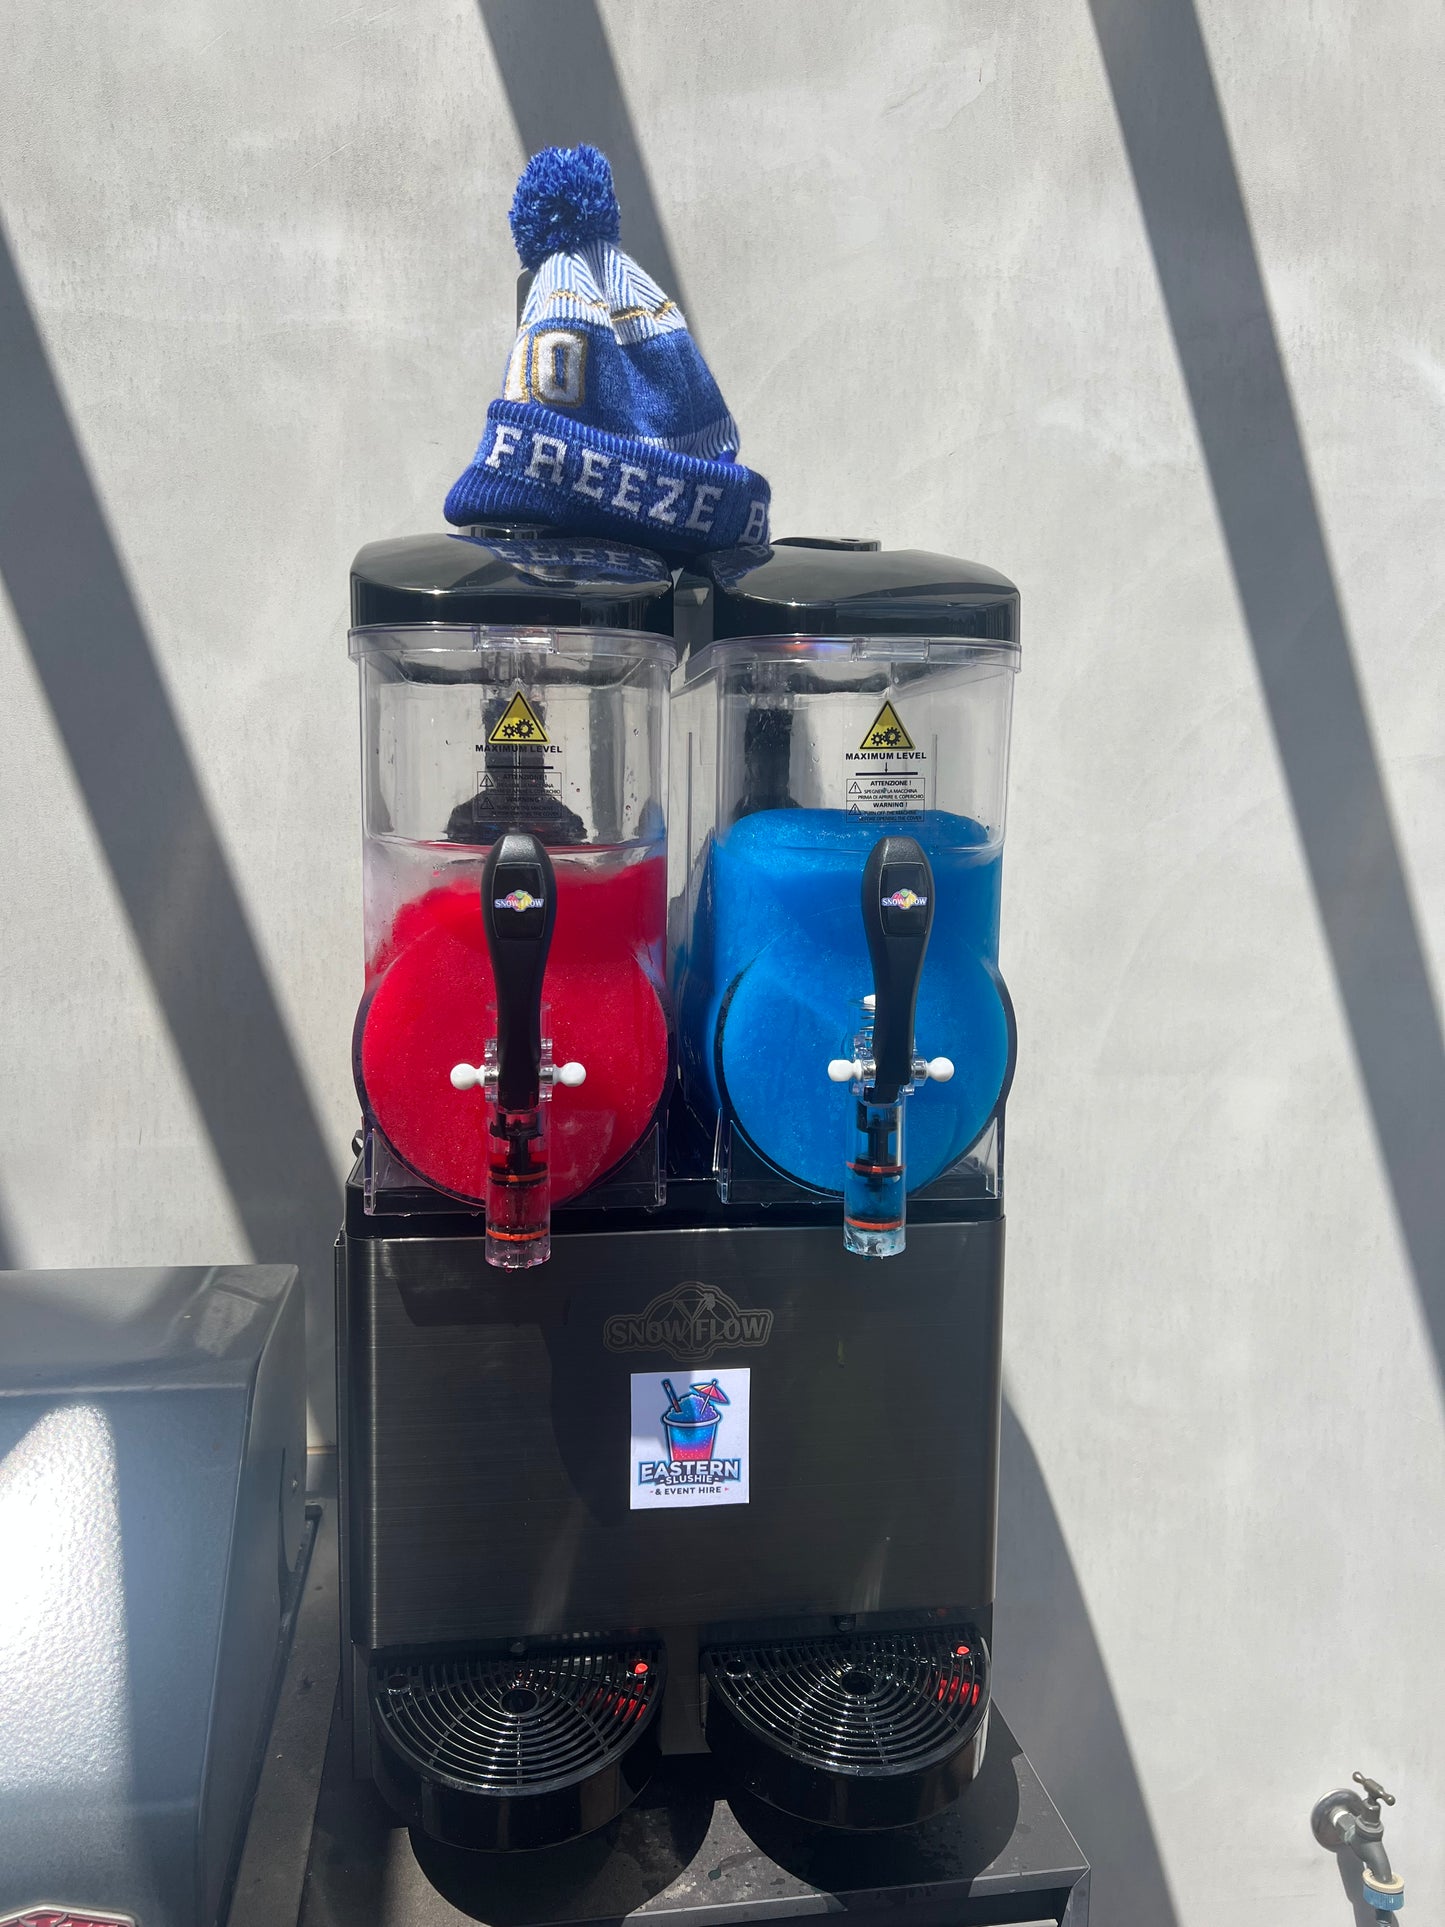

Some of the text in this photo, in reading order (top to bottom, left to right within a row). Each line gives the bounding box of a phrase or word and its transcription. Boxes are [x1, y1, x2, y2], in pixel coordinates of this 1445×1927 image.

[485, 424, 723, 533] FREEZE
[475, 744, 563, 753] MAXIMUM LEVEL
[845, 752, 927, 760] MAXIMUM LEVEL
[611, 1316, 765, 1345] SNOW FLOW
[641, 1460, 739, 1482] EASTERN
[655, 1486, 722, 1496] & EVENT HIRE
